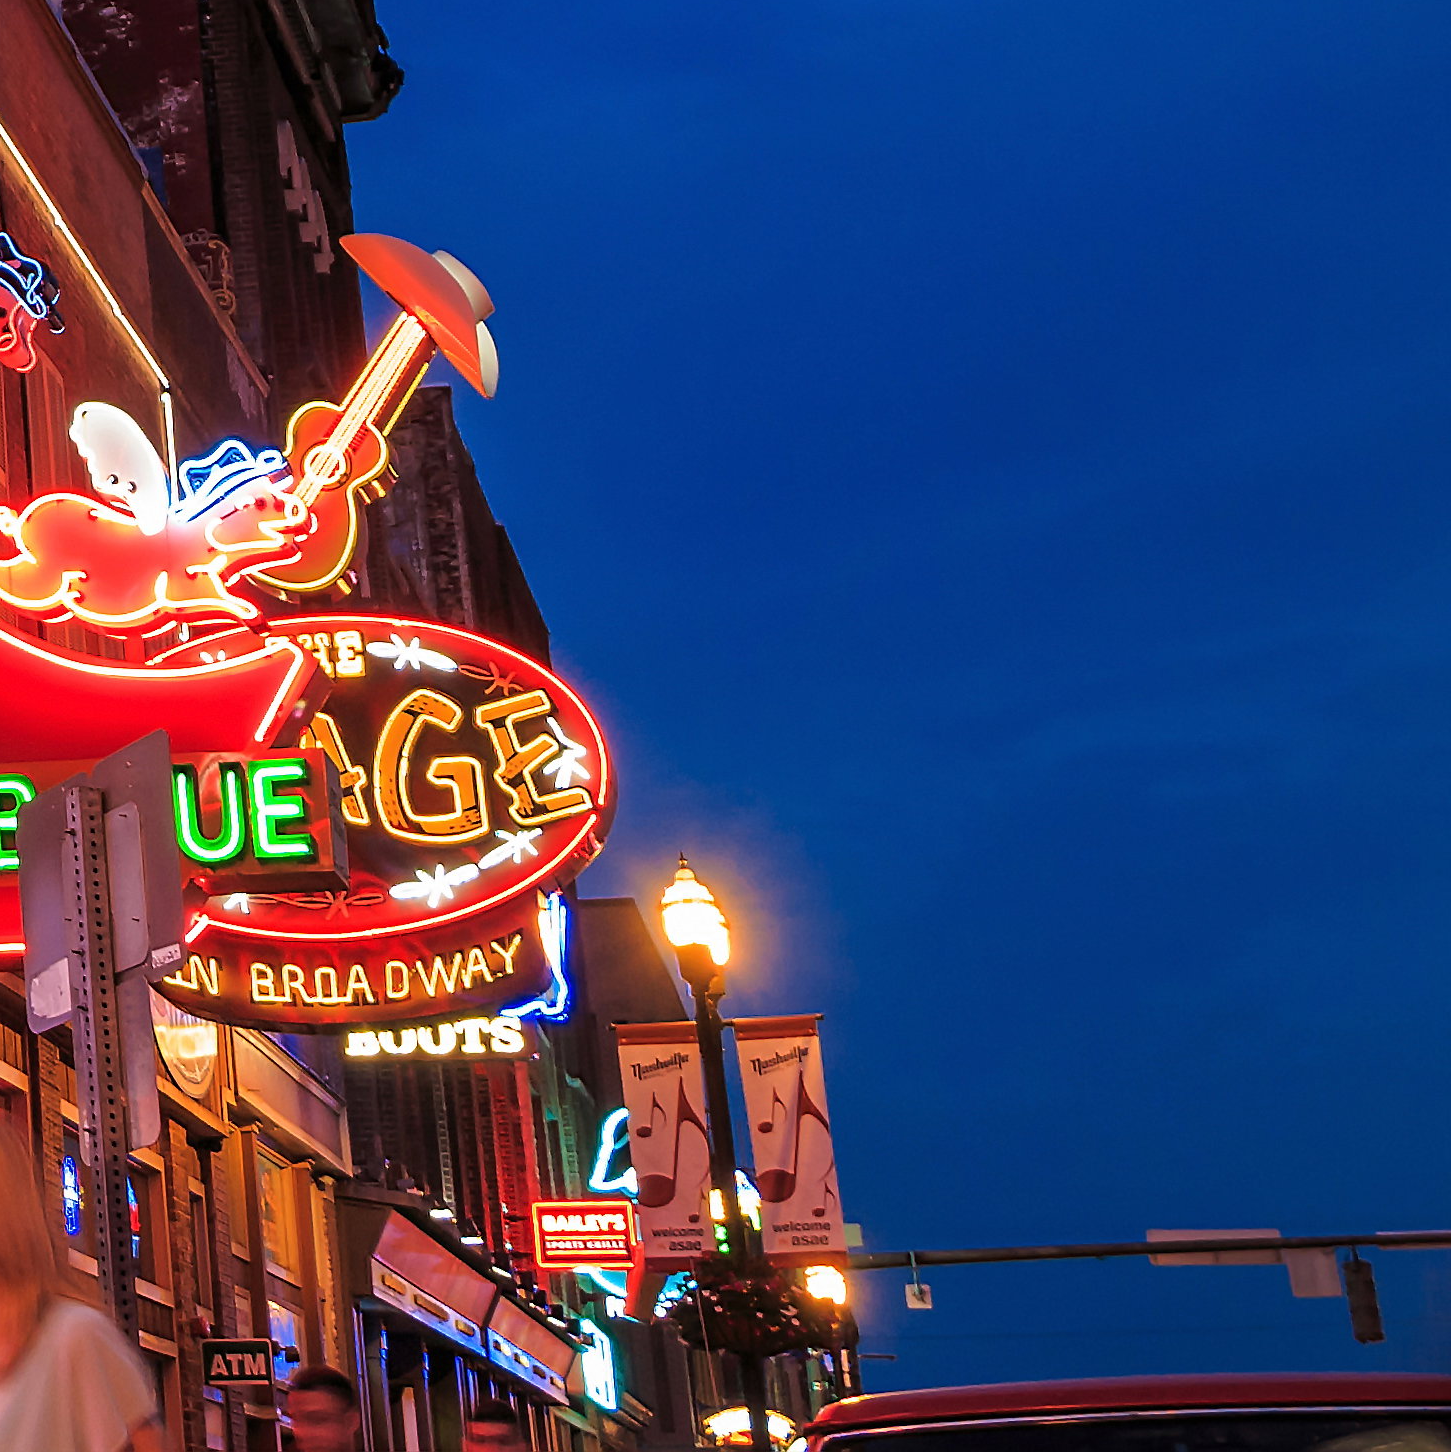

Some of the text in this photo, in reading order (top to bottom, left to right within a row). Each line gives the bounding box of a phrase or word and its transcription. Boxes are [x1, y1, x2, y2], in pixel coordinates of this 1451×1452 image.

[299, 688, 593, 844] AGE
[250, 931, 523, 1005] BROADWAY
[631, 1052, 691, 1081] Nashville
[750, 1046, 810, 1076] Nashville
[541, 1213, 627, 1233] BAILEY'S
[771, 1220, 832, 1233] welcome
[210, 1352, 267, 1377] ATM
